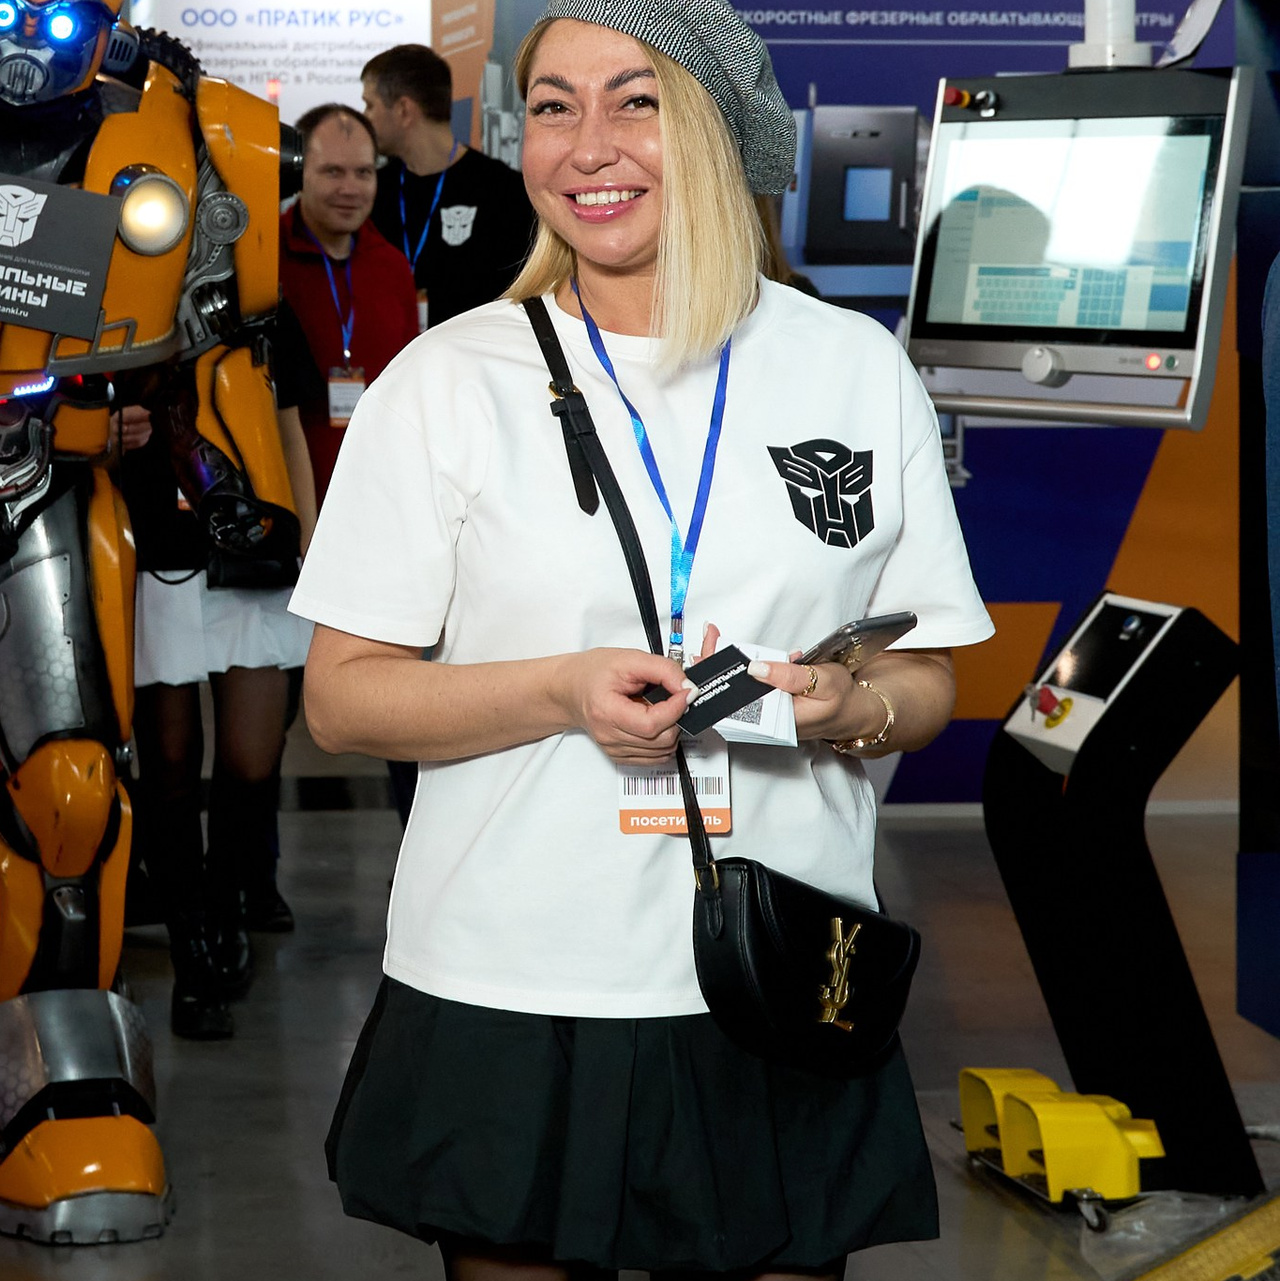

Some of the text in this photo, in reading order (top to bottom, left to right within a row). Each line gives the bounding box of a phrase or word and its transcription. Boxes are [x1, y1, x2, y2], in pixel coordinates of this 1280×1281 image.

[181, 8, 405, 28] ООО «ПРАТИК РУС»
[845, 11, 945, 27] ФРЕЗЕРНЫЕ
[630, 815, 722, 827] посетиль
